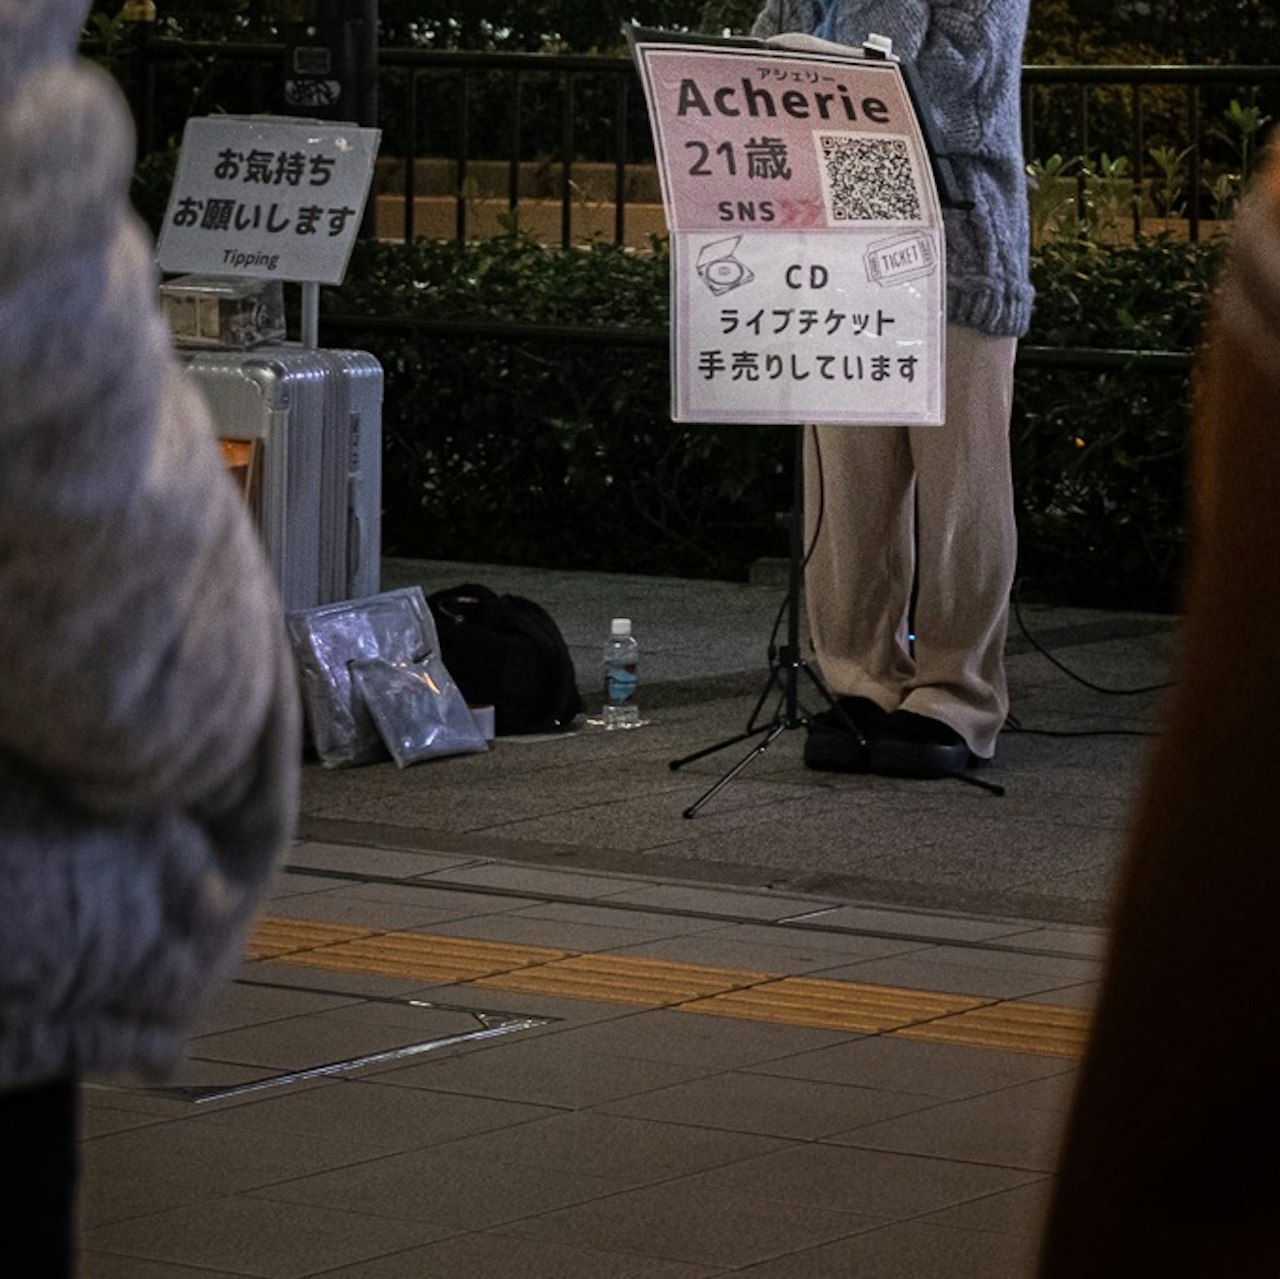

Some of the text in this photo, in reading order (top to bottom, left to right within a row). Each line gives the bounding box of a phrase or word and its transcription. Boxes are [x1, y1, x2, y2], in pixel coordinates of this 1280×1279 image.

[757, 66, 836, 85] アシェリー
[676, 78, 891, 124] Acherie
[214, 147, 336, 186] お気持ち
[685, 136, 793, 182] 21歳
[173, 196, 356, 237] お願いします
[718, 200, 776, 223] SNS
[222, 249, 280, 271] Tipping
[881, 245, 919, 271] TICKET
[785, 263, 829, 291] CD
[718, 308, 896, 337] ライブチケット
[696, 350, 919, 384] 手売りしています
